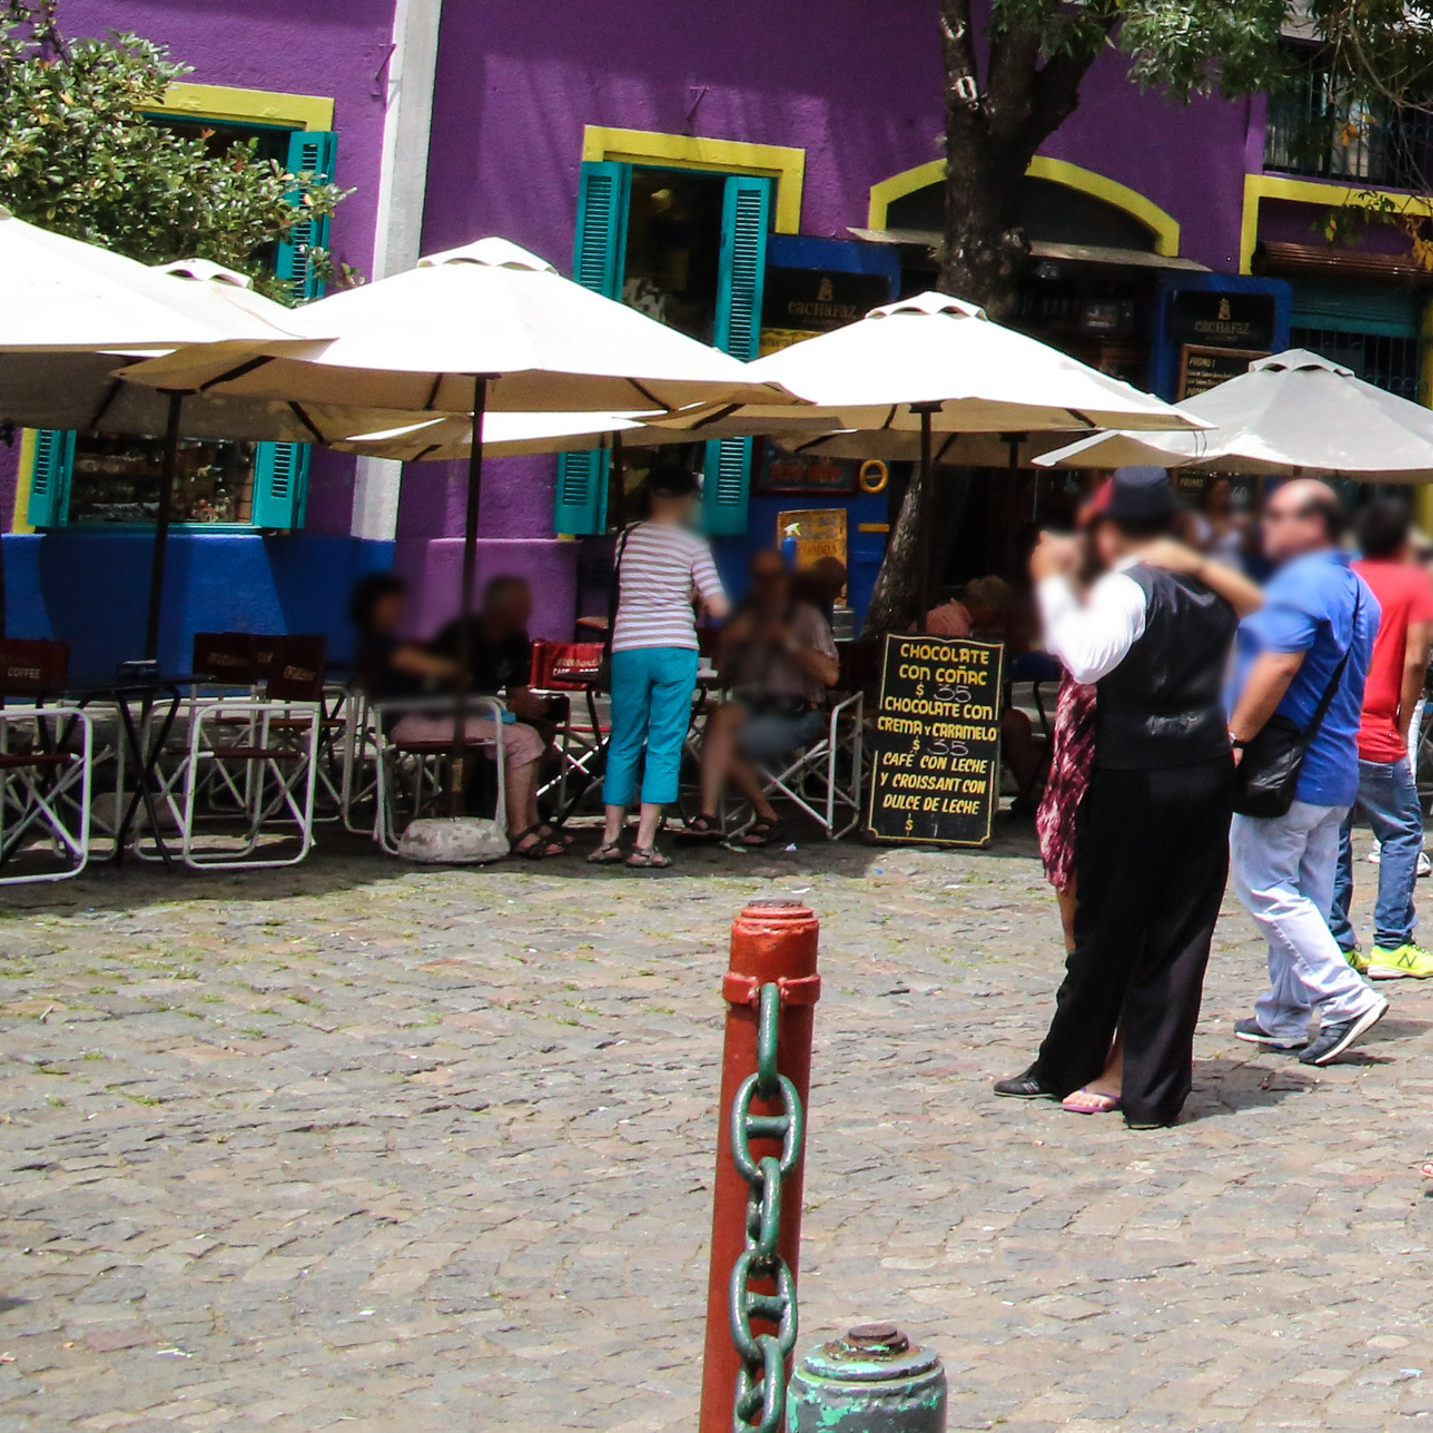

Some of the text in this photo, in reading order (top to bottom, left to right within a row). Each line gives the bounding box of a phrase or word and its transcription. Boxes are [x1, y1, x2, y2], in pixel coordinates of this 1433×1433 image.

[900, 643, 990, 665] CHOCOLATE
[7, 666, 41, 680] COFFEE
[899, 664, 988, 685] CON COÑAC
[933, 683, 972, 703] 35
[884, 696, 993, 721] CHOCOLATE CON
[877, 716, 922, 735] CREMA
[932, 722, 998, 741] CARAMELO
[927, 738, 969, 756] 35
[920, 755, 948, 770] CON
[951, 757, 988, 774] LECHE
[880, 772, 987, 795] Y CROISSANT CON
[882, 793, 980, 815] DULCE DE LECHE
